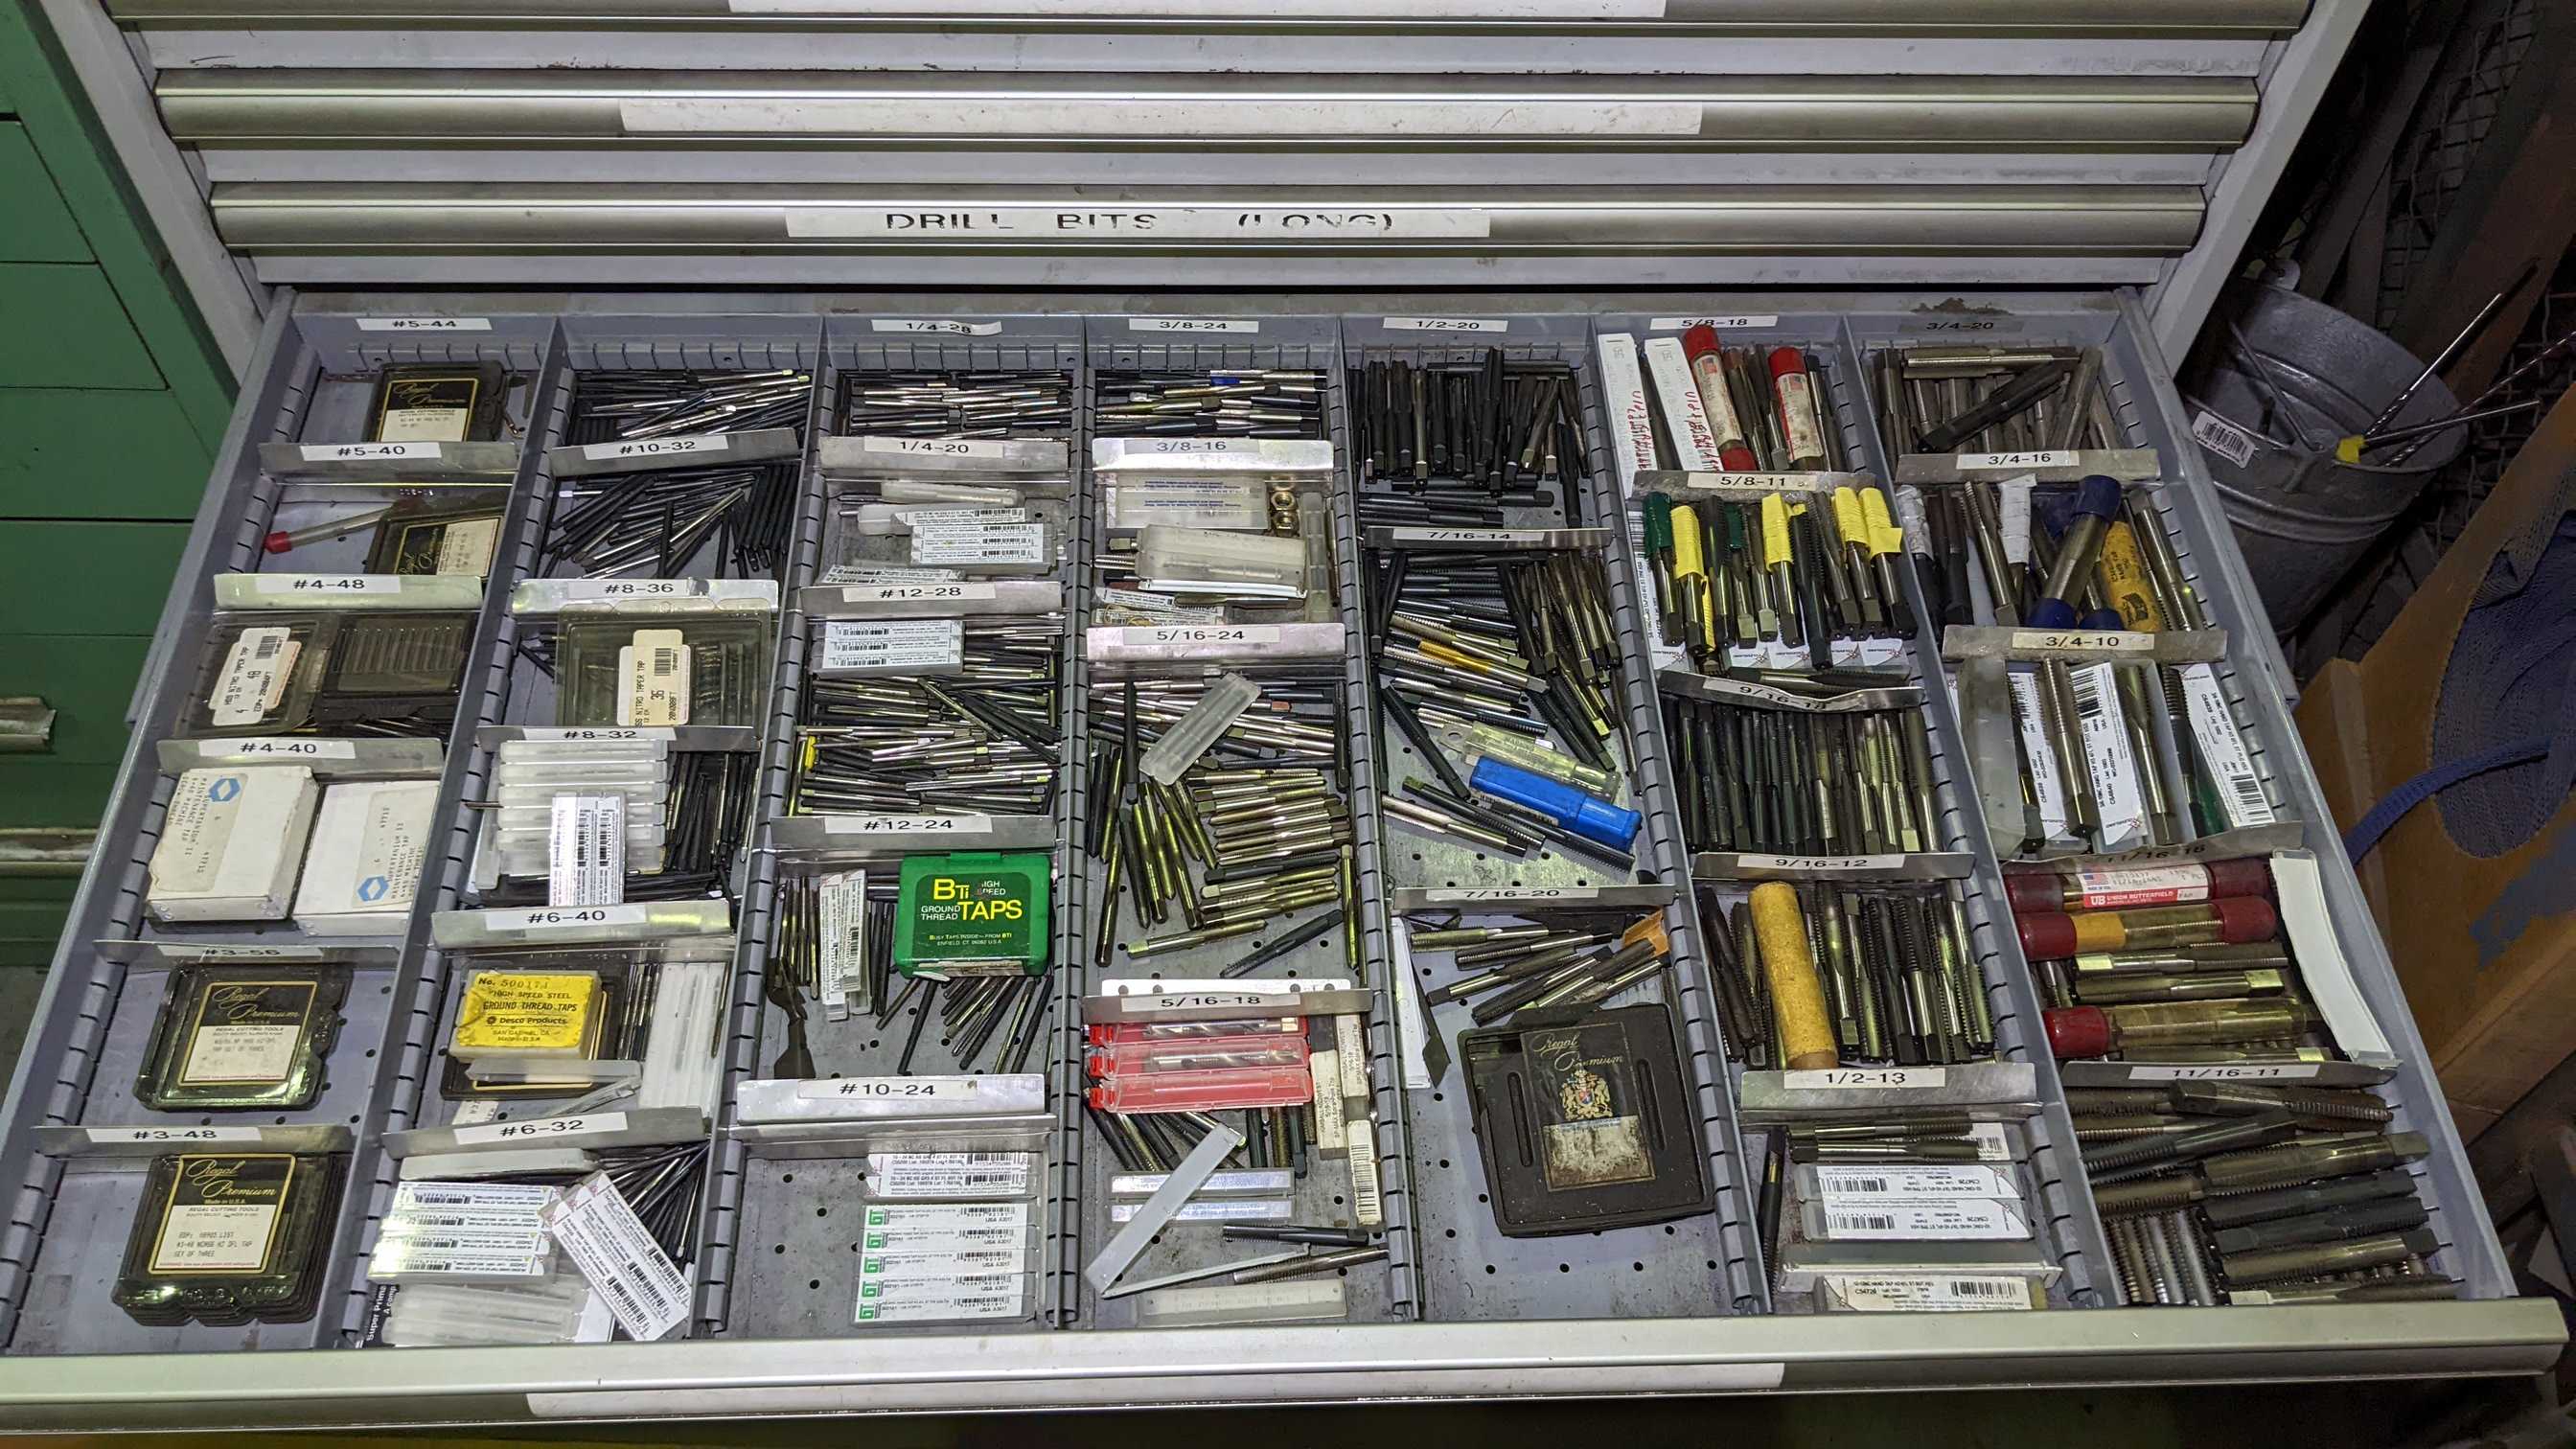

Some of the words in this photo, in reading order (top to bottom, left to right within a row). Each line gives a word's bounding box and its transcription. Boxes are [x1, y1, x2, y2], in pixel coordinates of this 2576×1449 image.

[1057, 214, 1158, 229] BITS
[907, 323, 972, 334] 1/4-28
[1160, 321, 1228, 330] 3/8-24
[1416, 321, 1480, 330] 1/2-20
[1681, 318, 1749, 328] 5/8-18
[1926, 321, 1994, 331] 3/4-20
[337, 446, 406, 456] #5-40
[619, 438, 696, 454] #10-32
[900, 441, 969, 454] 1/4-20
[1157, 441, 1227, 452] 3/8-16
[1989, 452, 2052, 466] 3/4-16
[1720, 476, 1786, 487] 5/8-11
[1427, 532, 1511, 540] 7/16-14
[293, 579, 365, 589] #4-48
[605, 583, 675, 593] #8-36
[880, 586, 962, 599] #12-28
[1157, 630, 1245, 641] 5/16-24
[2045, 635, 2120, 648] 3/4-10
[564, 730, 637, 740] #8-32
[240, 744, 318, 754] #4-40
[863, 819, 954, 831] #12-24
[1776, 858, 1869, 868] 9/16-12
[1463, 889, 1560, 899] 7/16-20
[2090, 895, 2105, 906] UB
[2129, 890, 2174, 899] BUTTERFIELD
[956, 899, 1023, 921] TAPS
[528, 910, 607, 924] #6-40
[483, 1001, 518, 1010] GROUND
[520, 1001, 553, 1010] THREAD
[557, 1002, 578, 1012] TAPS
[1161, 996, 1261, 1008] 5/16-18
[1826, 1072, 1906, 1085] 1/2-13
[2172, 1068, 2281, 1078] 11/16-11
[840, 1083, 936, 1096] #10-24
[500, 1119, 585, 1138] #6-32
[132, 1130, 218, 1139] #3-48
[185, 1158, 246, 1186] Regal
[200, 1179, 277, 1199] Premium
[367, 1311, 380, 1341] Super
